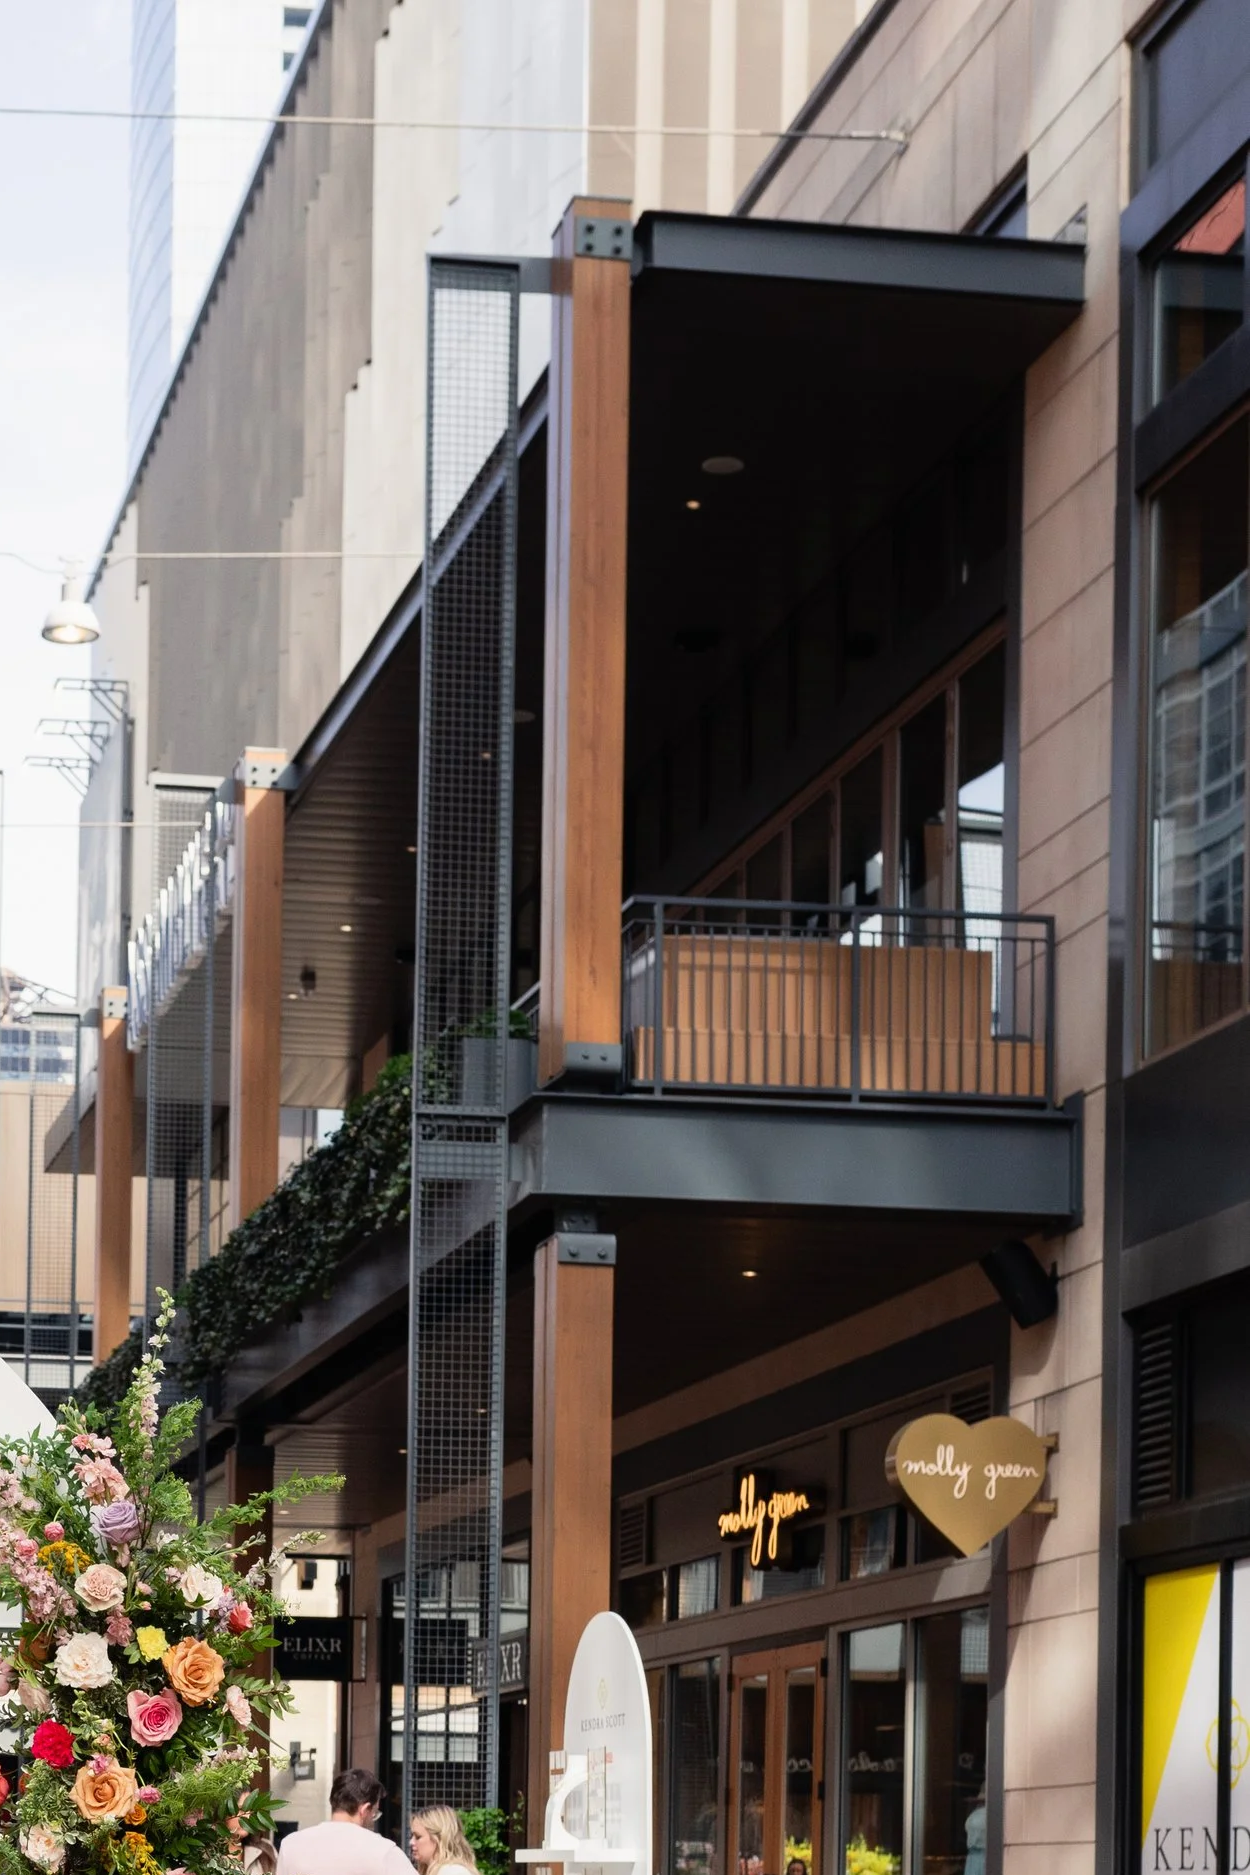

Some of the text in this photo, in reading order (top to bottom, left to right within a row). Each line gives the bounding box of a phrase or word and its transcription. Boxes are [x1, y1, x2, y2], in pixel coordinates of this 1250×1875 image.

[901, 1444, 1040, 1501] molly green
[718, 1473, 810, 1567] molly green
[283, 1636, 342, 1653] ELIXR
[476, 1640, 522, 1688] EXR
